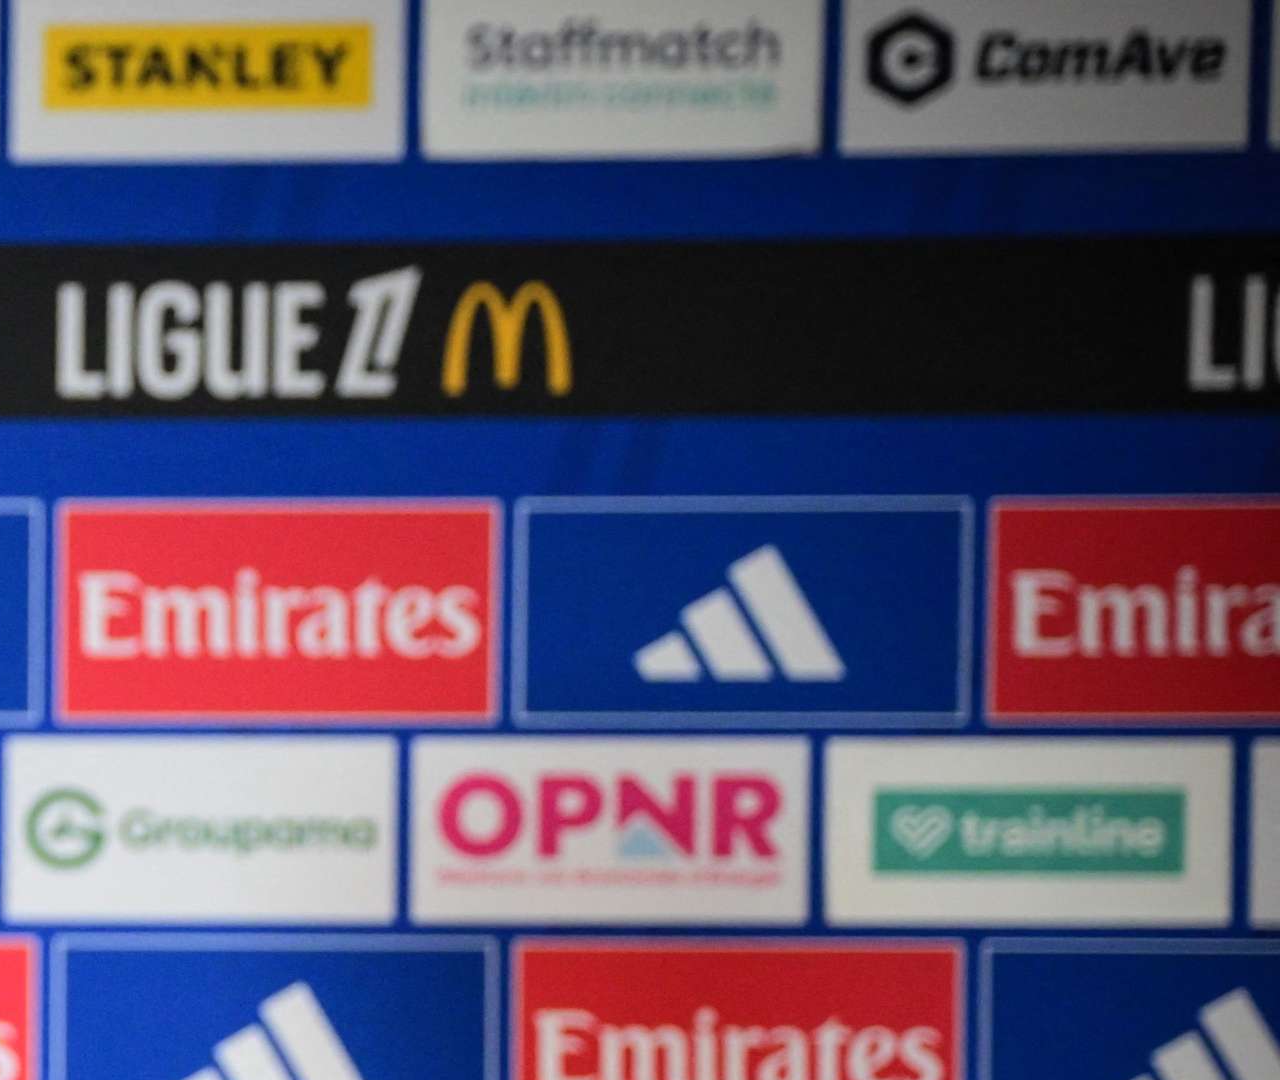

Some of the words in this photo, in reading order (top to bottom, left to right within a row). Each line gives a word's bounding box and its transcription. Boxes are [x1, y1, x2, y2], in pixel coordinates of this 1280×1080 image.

[64, 42, 348, 90] STANLEY
[466, 18, 783, 70] Staffmatch
[975, 30, 1229, 81] ComAve
[55, 280, 325, 399] LIGUE
[78, 568, 481, 659] Emirates
[117, 809, 382, 857] Groupama
[438, 773, 783, 862] OPNR
[960, 804, 1166, 858] trainline
